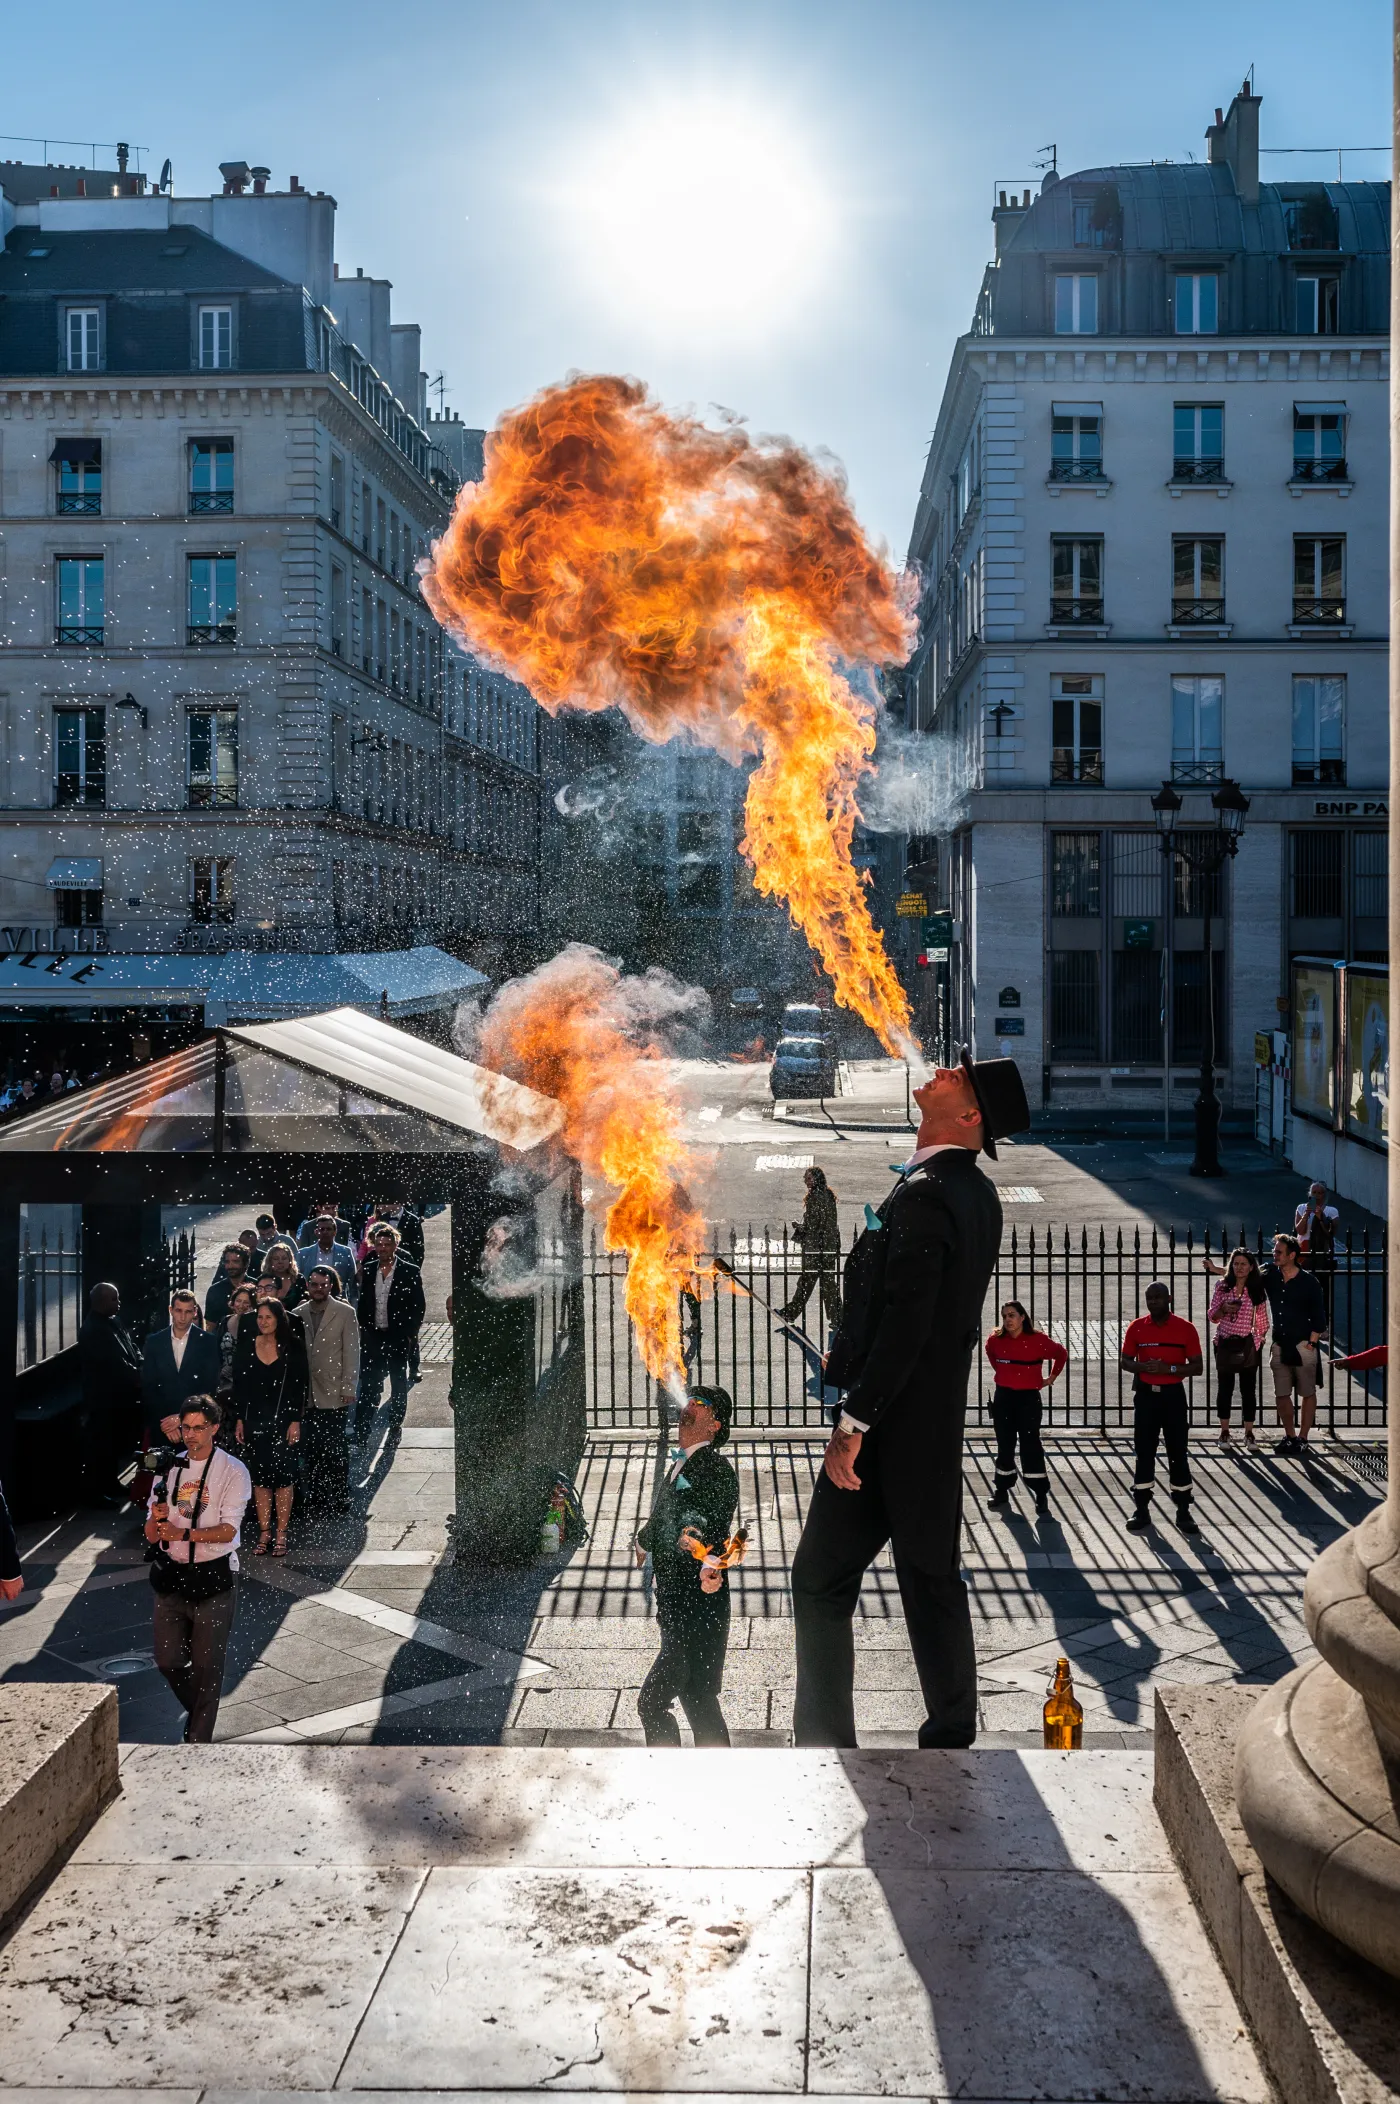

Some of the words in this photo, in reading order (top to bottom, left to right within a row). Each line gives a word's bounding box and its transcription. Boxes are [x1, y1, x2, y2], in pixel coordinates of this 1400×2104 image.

[1316, 802, 1358, 814] BNP
[1363, 802, 1389, 814] PA
[2, 927, 110, 952] VILLE
[174, 933, 301, 949] BRASSERIE
[0, 952, 104, 984] LLE
